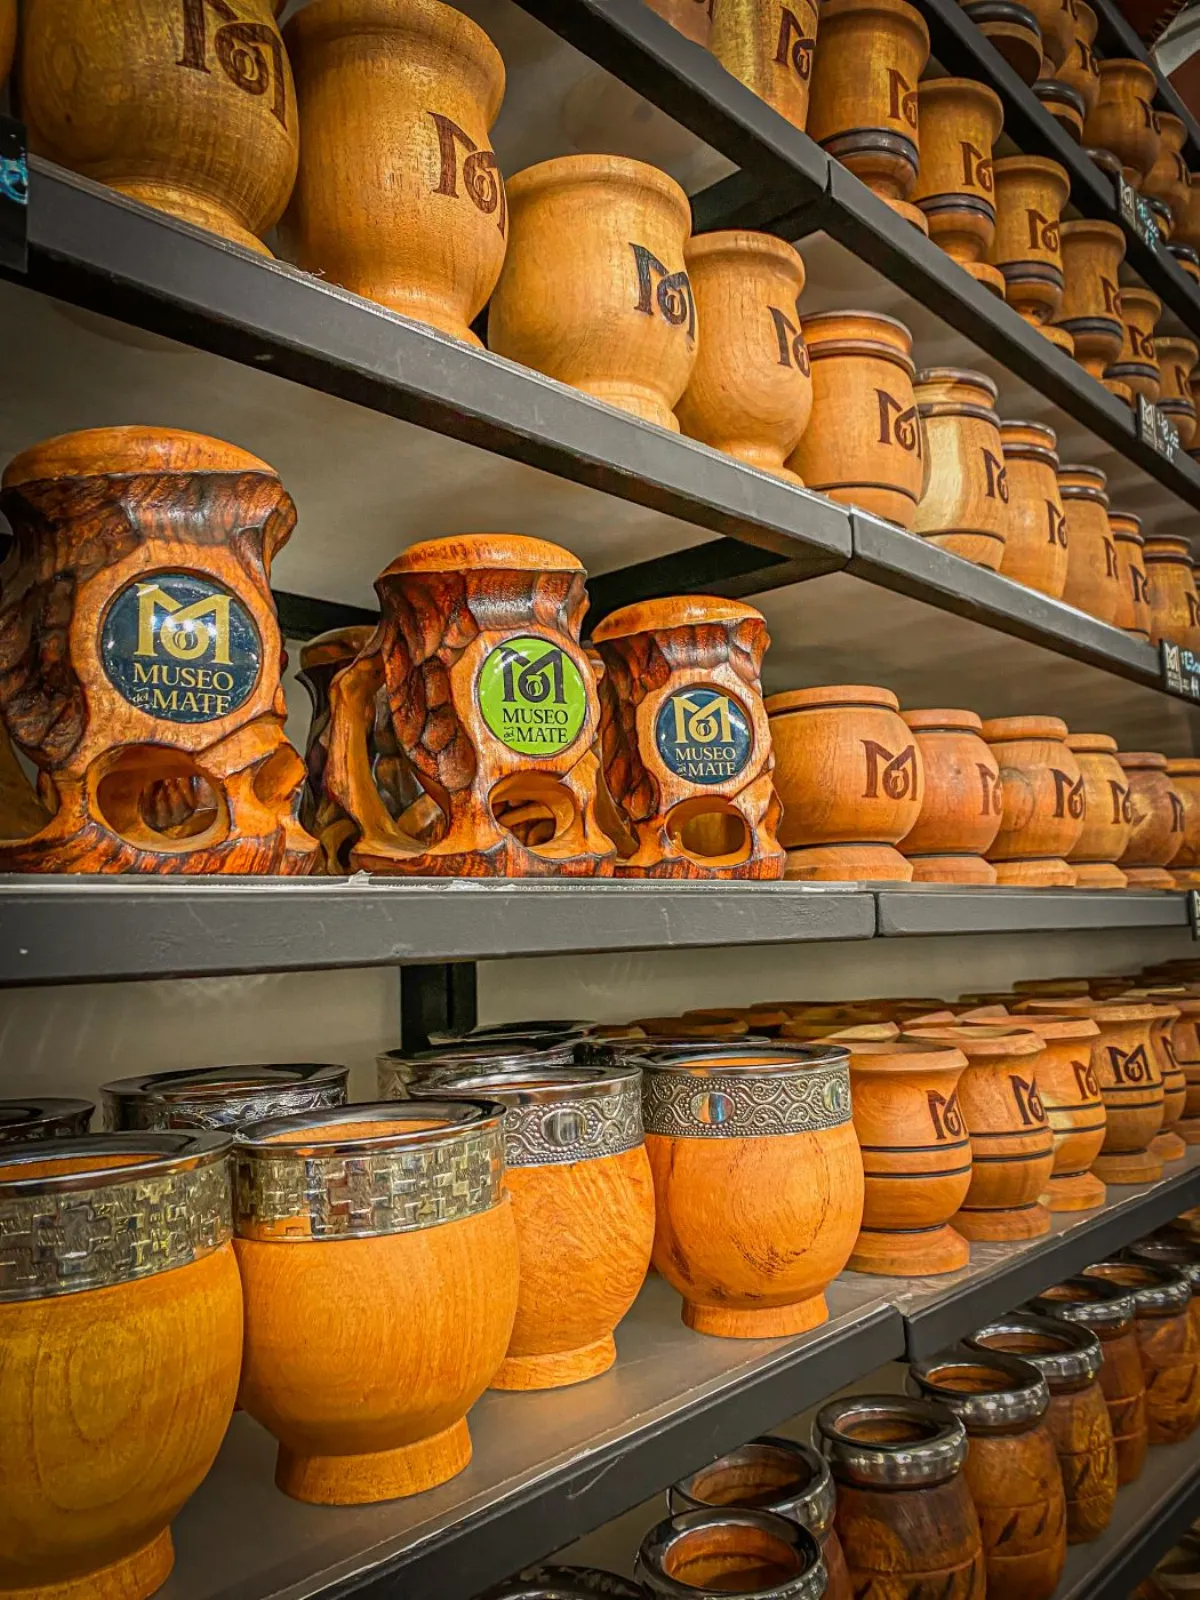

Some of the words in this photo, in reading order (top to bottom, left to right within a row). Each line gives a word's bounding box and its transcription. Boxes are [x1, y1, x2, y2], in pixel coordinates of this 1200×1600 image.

[132, 662, 234, 691] MUSEO
[152, 688, 231, 715] MATE
[502, 708, 569, 725] MUSEO
[516, 727, 569, 744] MATE
[675, 746, 737, 761] MUSEO
[688, 761, 737, 777] MATE
